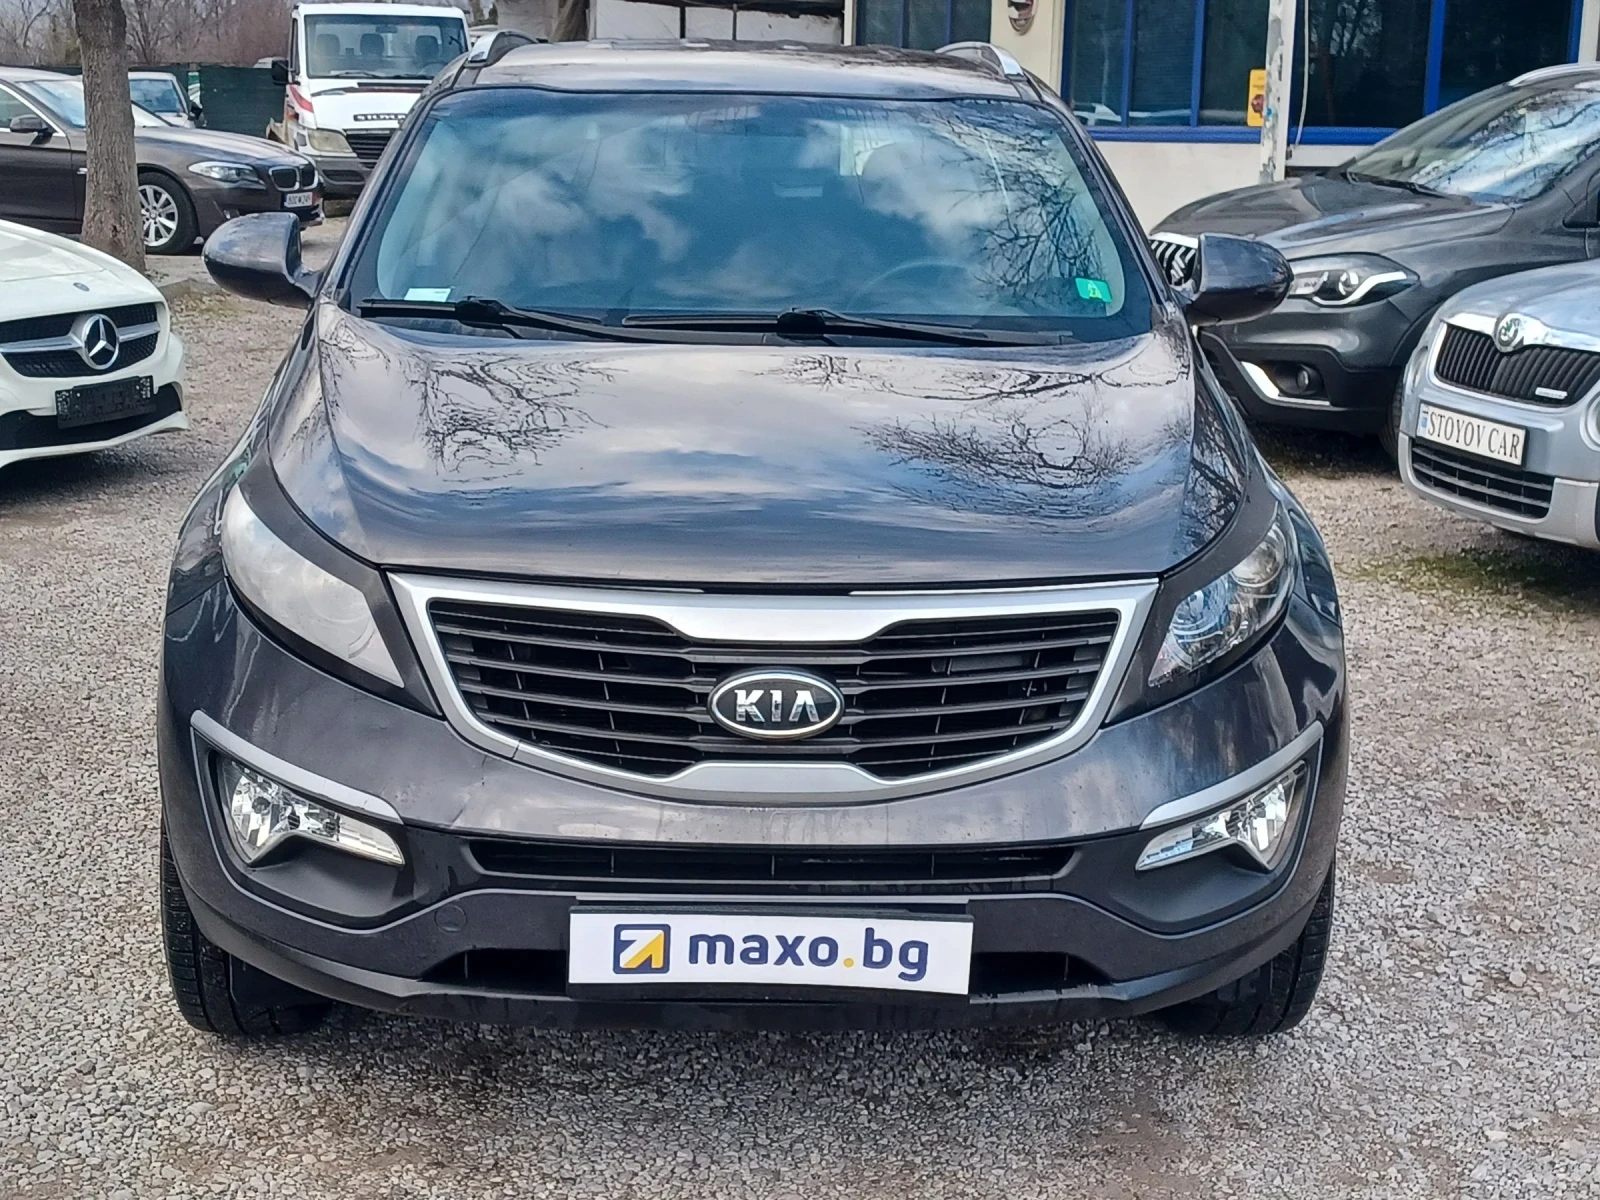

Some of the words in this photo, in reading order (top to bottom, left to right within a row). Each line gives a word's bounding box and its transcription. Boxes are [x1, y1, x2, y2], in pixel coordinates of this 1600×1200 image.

[1427, 411, 1485, 448] STOYOV
[1488, 428, 1520, 459] CAR
[734, 689, 820, 723] KIA
[688, 927, 929, 982] maxo.bg
